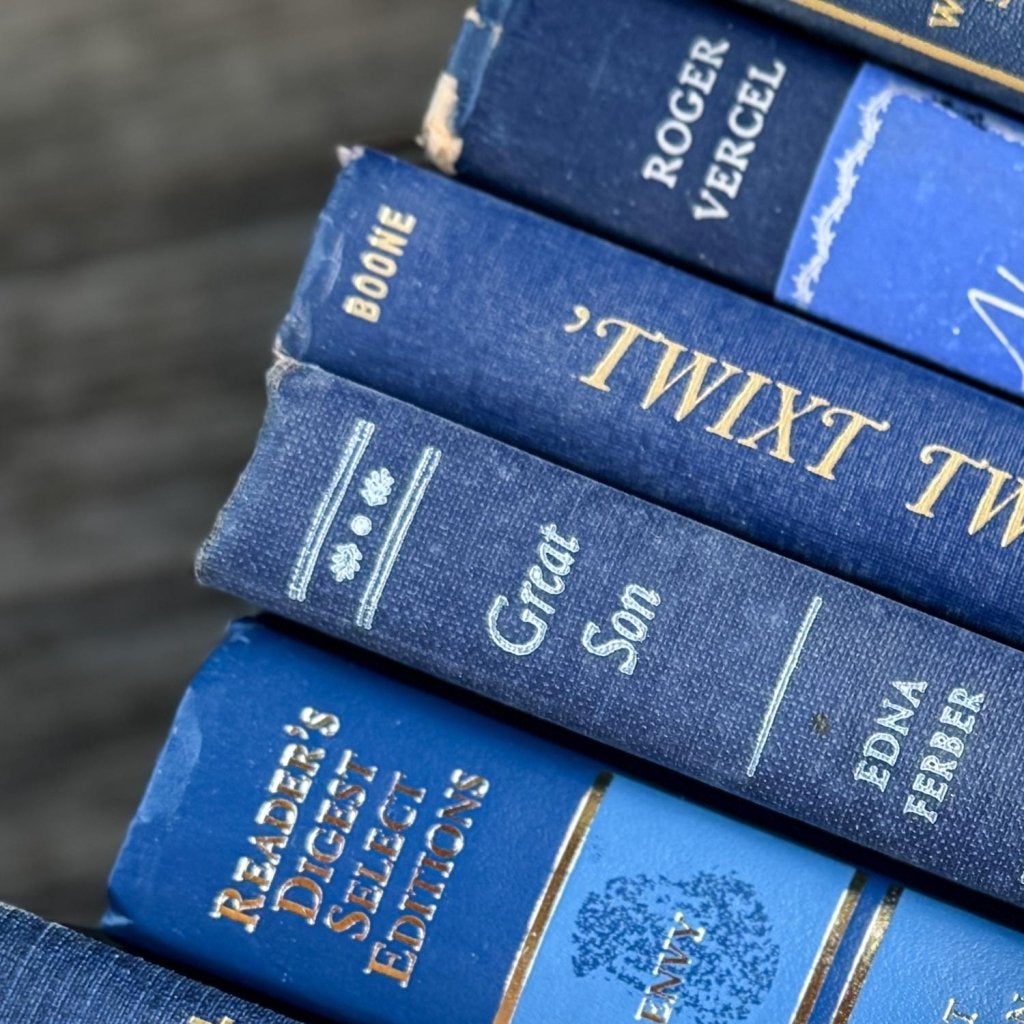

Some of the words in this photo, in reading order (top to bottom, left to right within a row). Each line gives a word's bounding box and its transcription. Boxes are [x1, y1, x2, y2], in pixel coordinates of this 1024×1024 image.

[643, 36, 730, 189] ROGER
[693, 59, 786, 224] VERCEL
[342, 205, 417, 324] BOONE
[486, 523, 581, 656] Great
[582, 583, 661, 675] Son
[853, 680, 928, 793] EDNA
[903, 687, 985, 824] FERBER
[209, 706, 341, 933] READER'S
[271, 748, 378, 925] DIGEST
[322, 770, 427, 942] SELECT
[363, 768, 491, 988] EDITIONS
